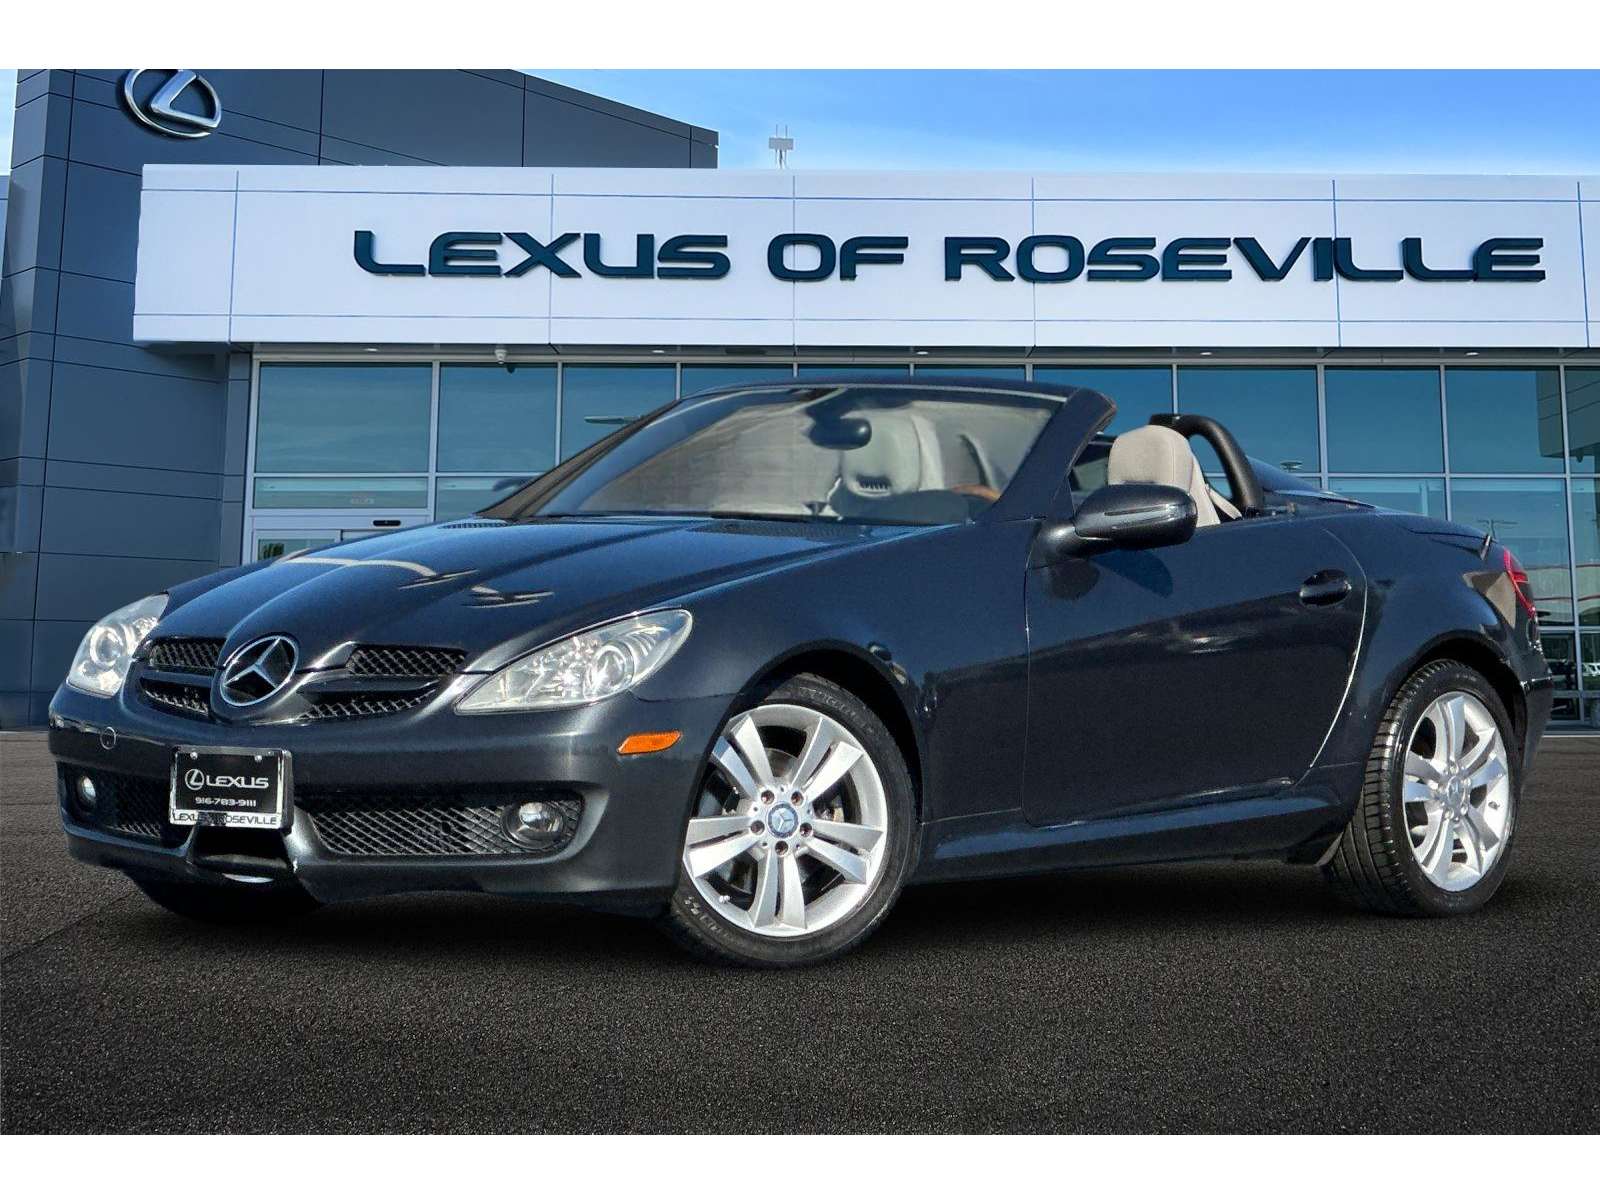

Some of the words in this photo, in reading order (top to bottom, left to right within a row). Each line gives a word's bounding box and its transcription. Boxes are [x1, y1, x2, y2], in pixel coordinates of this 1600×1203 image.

[353, 230, 731, 280] LEXUS
[767, 233, 909, 282] OF
[944, 235, 1546, 283] ROSEVILLE
[206, 775, 269, 789] LEXUS
